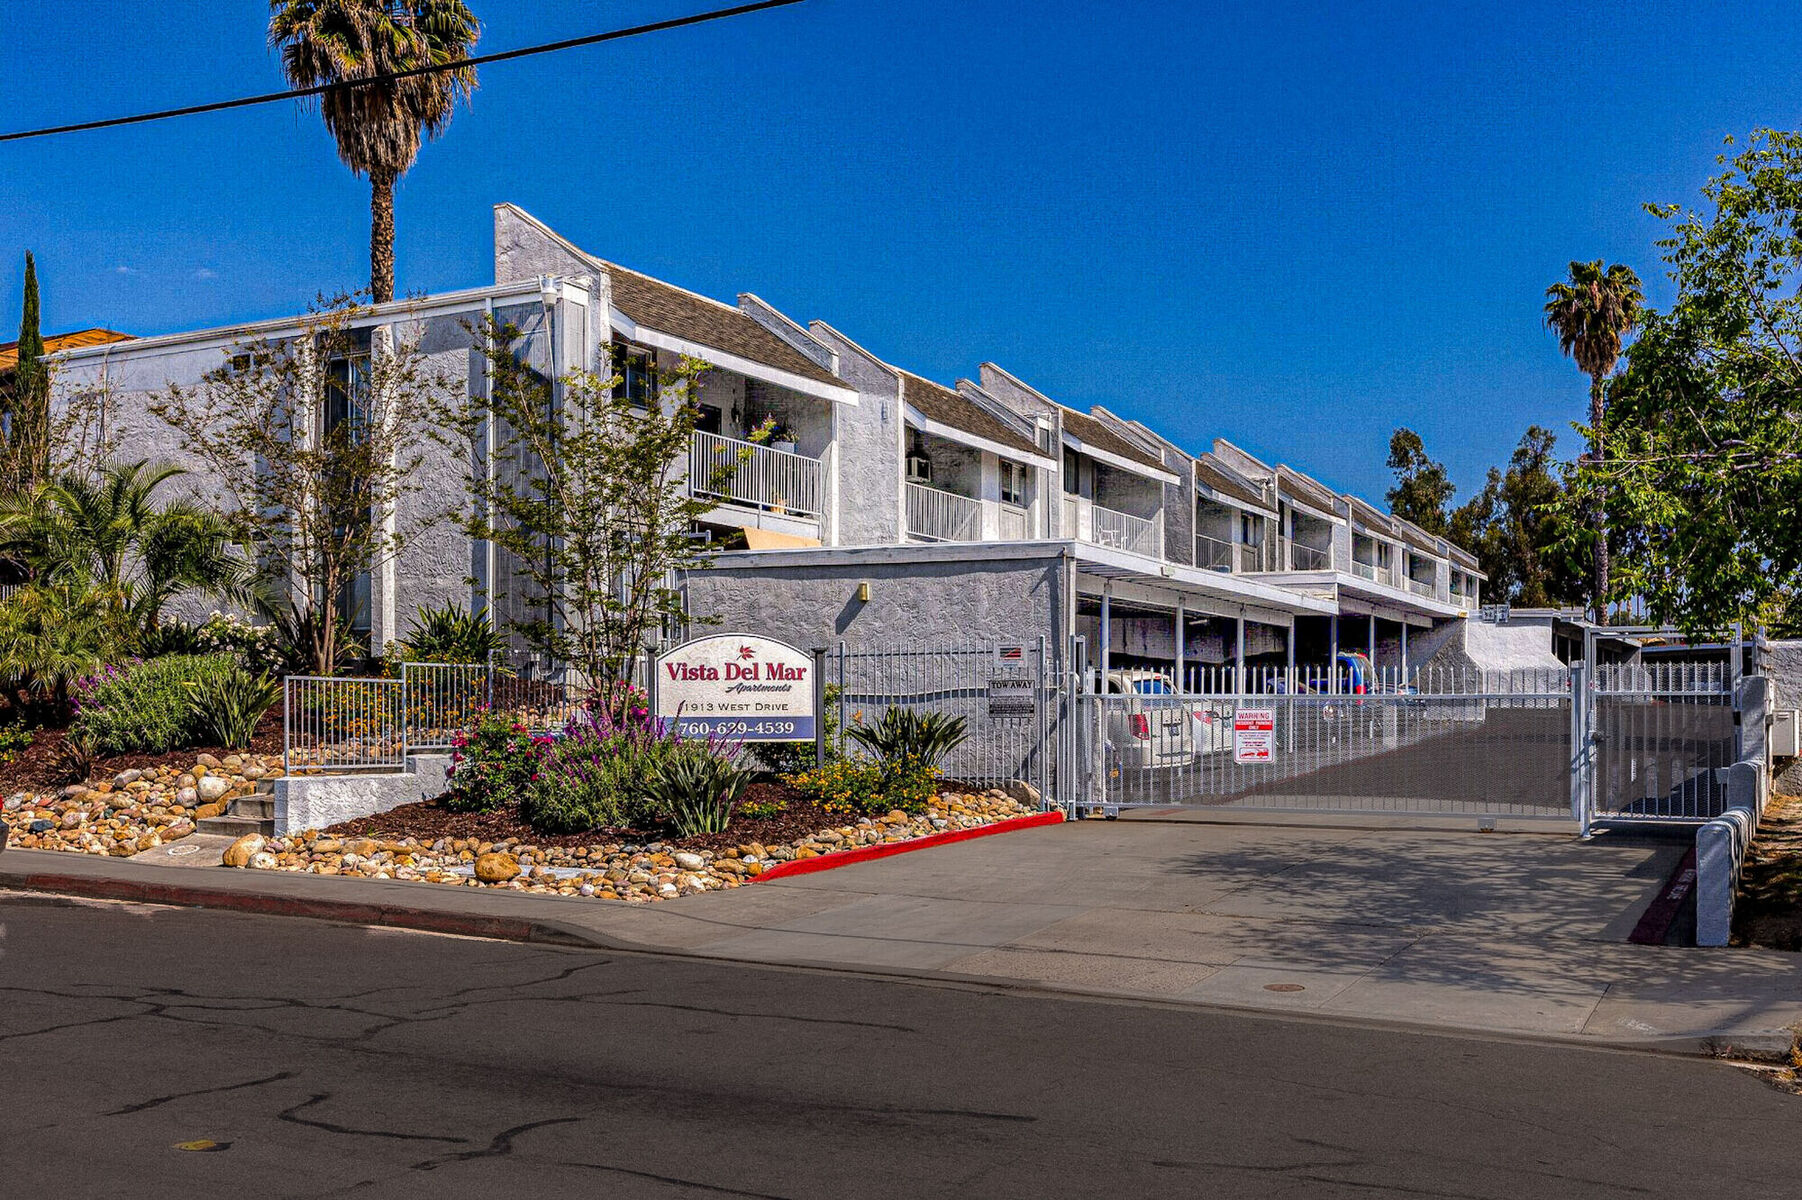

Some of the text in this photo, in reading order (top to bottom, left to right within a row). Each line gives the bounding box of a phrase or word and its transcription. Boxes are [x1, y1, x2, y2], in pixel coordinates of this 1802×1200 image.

[665, 662, 807, 681] Vista Del Mar
[725, 682, 792, 694] Apartments
[685, 703, 789, 711] 1913 WEST DRIVE
